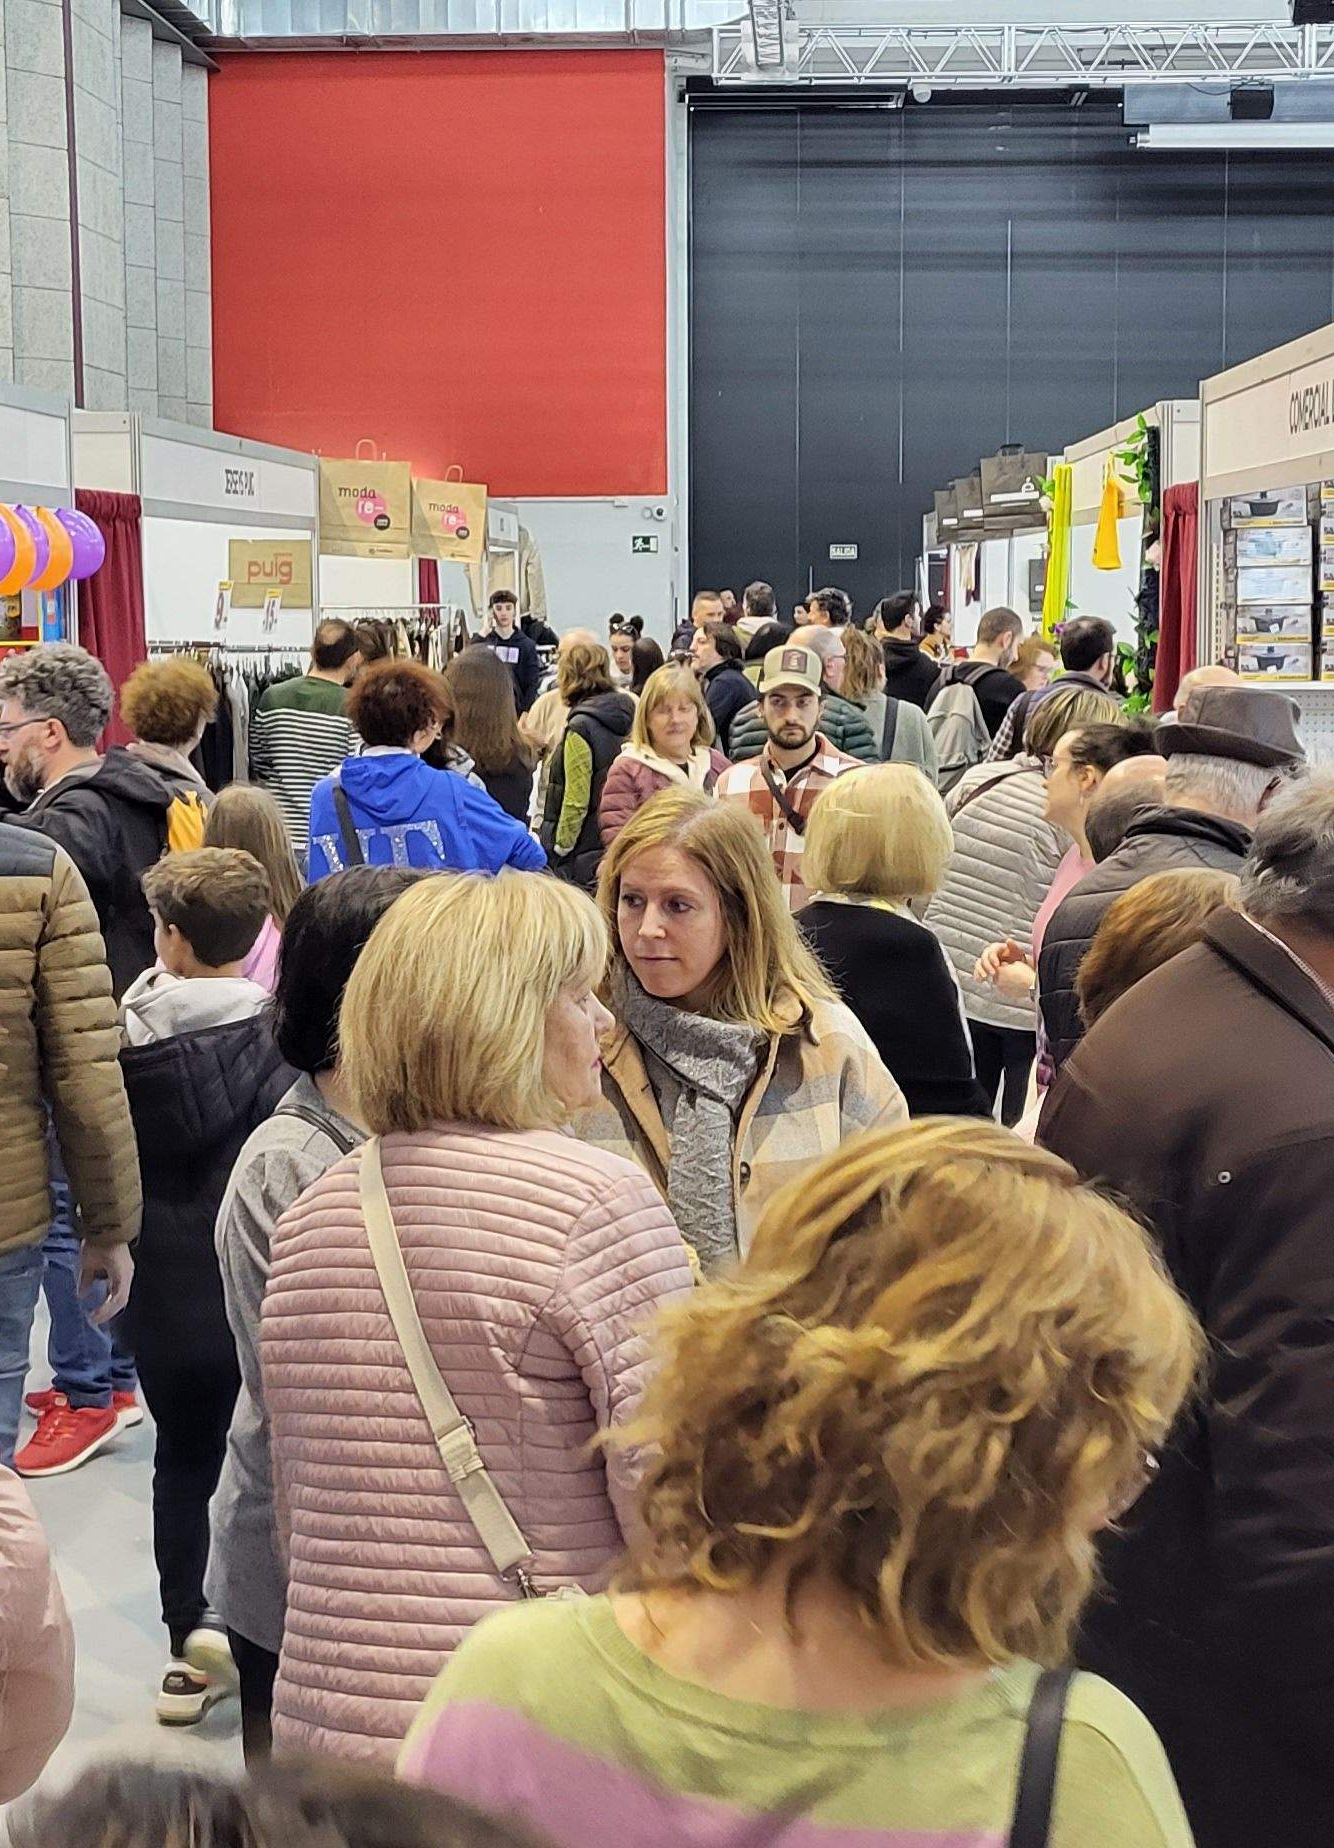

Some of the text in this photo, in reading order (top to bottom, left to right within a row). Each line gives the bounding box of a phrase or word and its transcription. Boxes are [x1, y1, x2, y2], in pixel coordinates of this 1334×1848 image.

[1290, 380, 1329, 434] COMERCIAL
[338, 486, 377, 499] moda
[428, 502, 459, 514] moda
